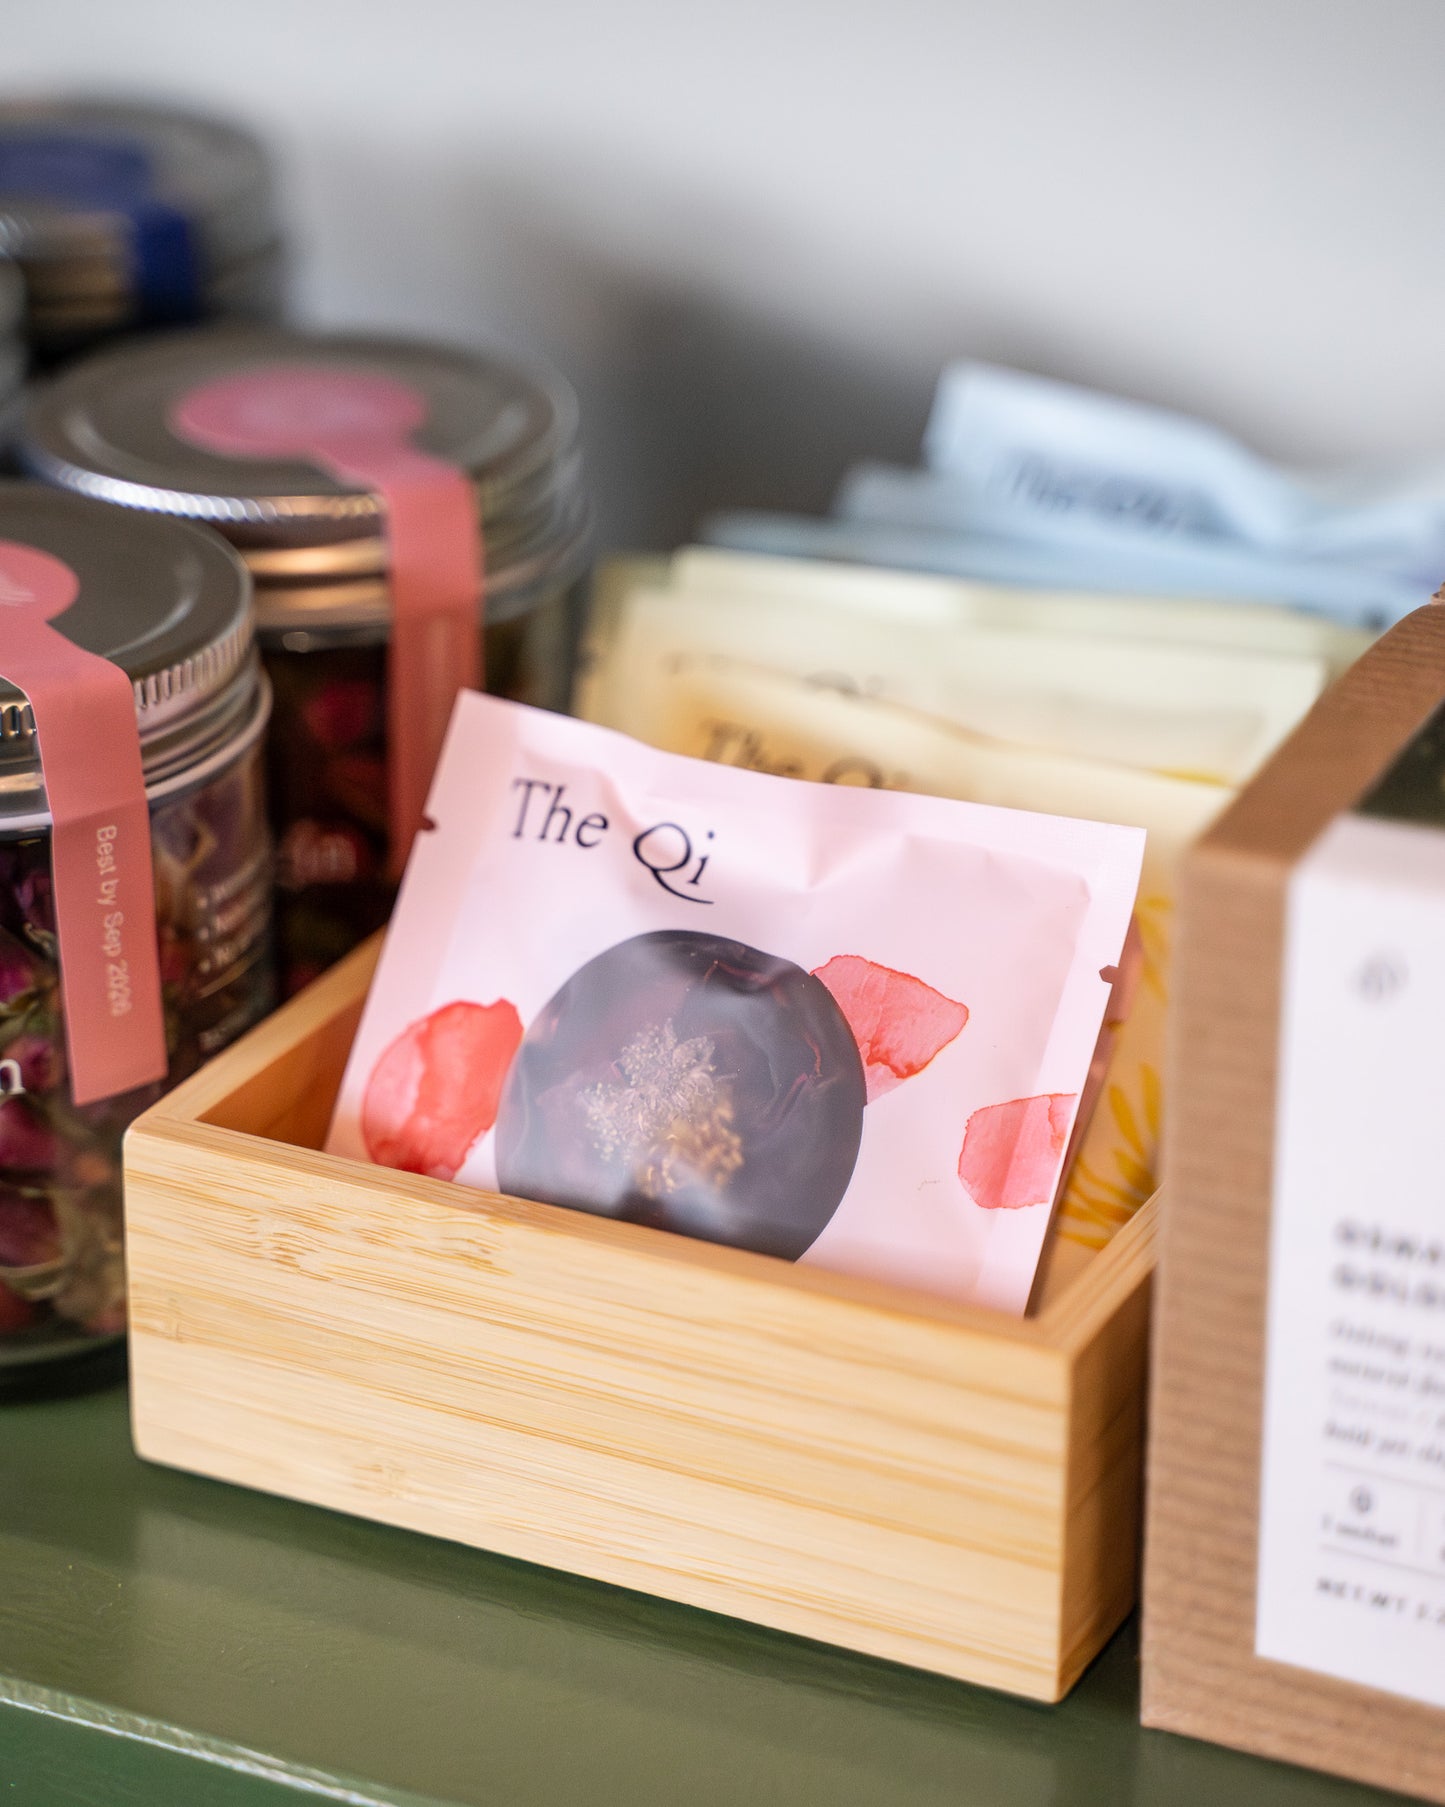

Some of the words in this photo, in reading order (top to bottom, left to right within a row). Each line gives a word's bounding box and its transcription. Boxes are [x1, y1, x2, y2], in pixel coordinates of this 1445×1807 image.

[96, 825, 118, 876] Best
[511, 777, 610, 848] The
[633, 822, 715, 905] Qi
[97, 878, 120, 906] by
[103, 911, 124, 958] Sep
